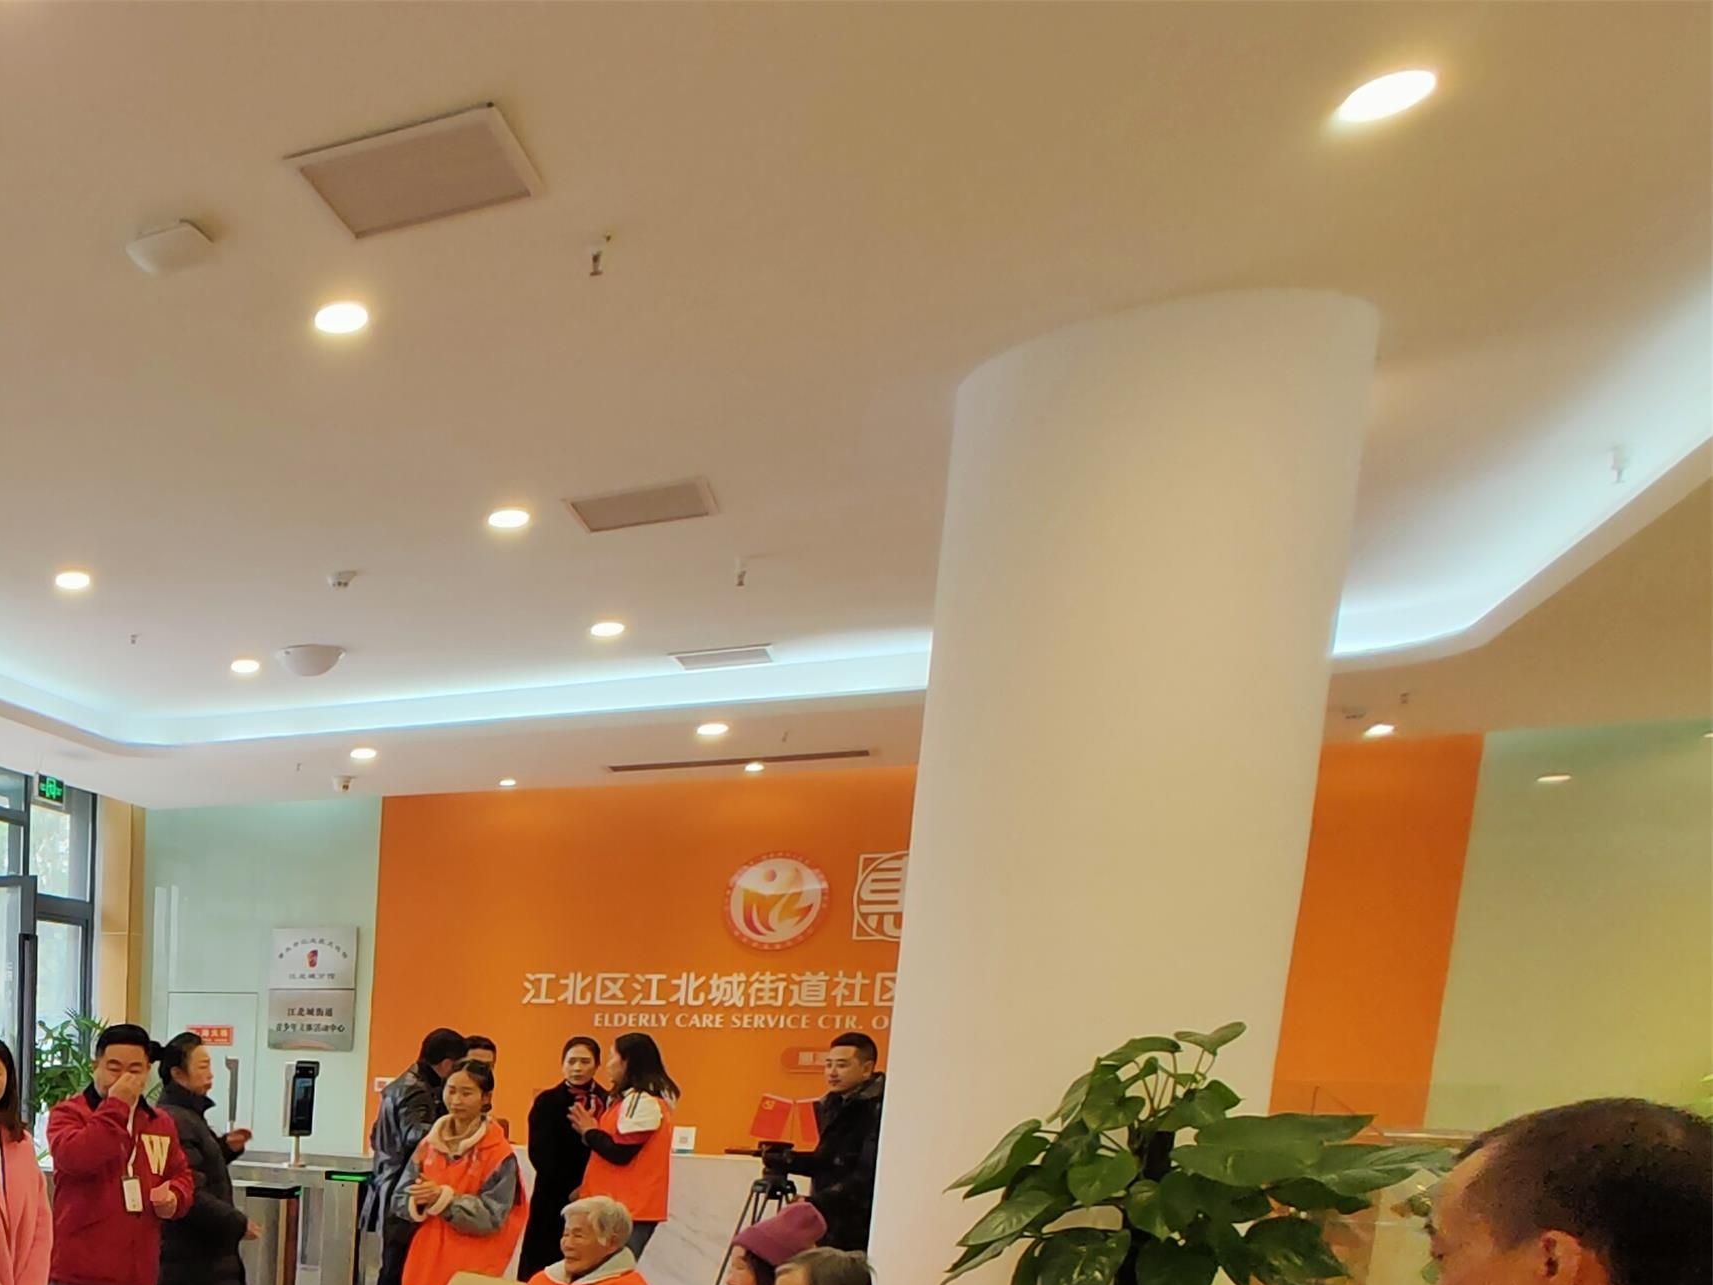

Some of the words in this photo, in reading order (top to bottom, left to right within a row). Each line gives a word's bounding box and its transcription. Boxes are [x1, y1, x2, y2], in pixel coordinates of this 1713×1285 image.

[522, 970, 897, 1008] 江北区江北城街道社区
[287, 1007, 333, 1017] 江北城街道
[593, 1013, 668, 1027] ELDERLY
[675, 1013, 724, 1028] CARE
[731, 1014, 810, 1029] SERVICE
[817, 1014, 863, 1030] CTR.
[141, 1133, 171, 1176] W
